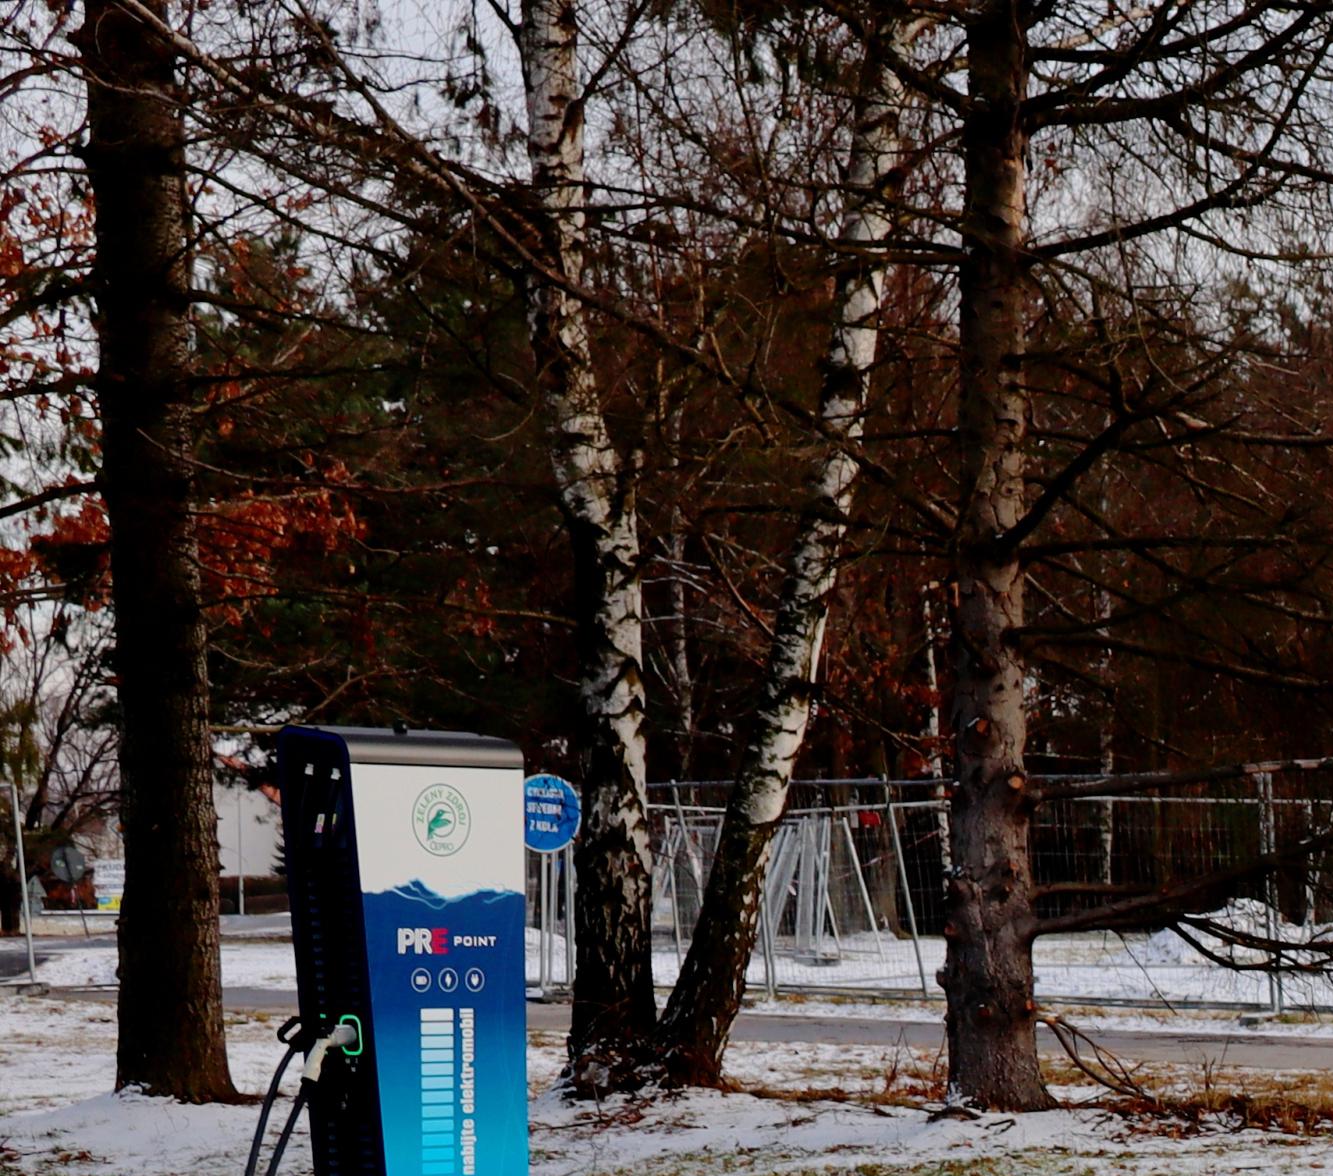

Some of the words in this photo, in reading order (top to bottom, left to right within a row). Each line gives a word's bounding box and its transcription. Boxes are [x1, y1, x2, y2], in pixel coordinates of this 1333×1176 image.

[397, 927, 449, 955] PRE
[453, 935, 497, 947] POINT
[459, 1007, 475, 1114] elektromobil
